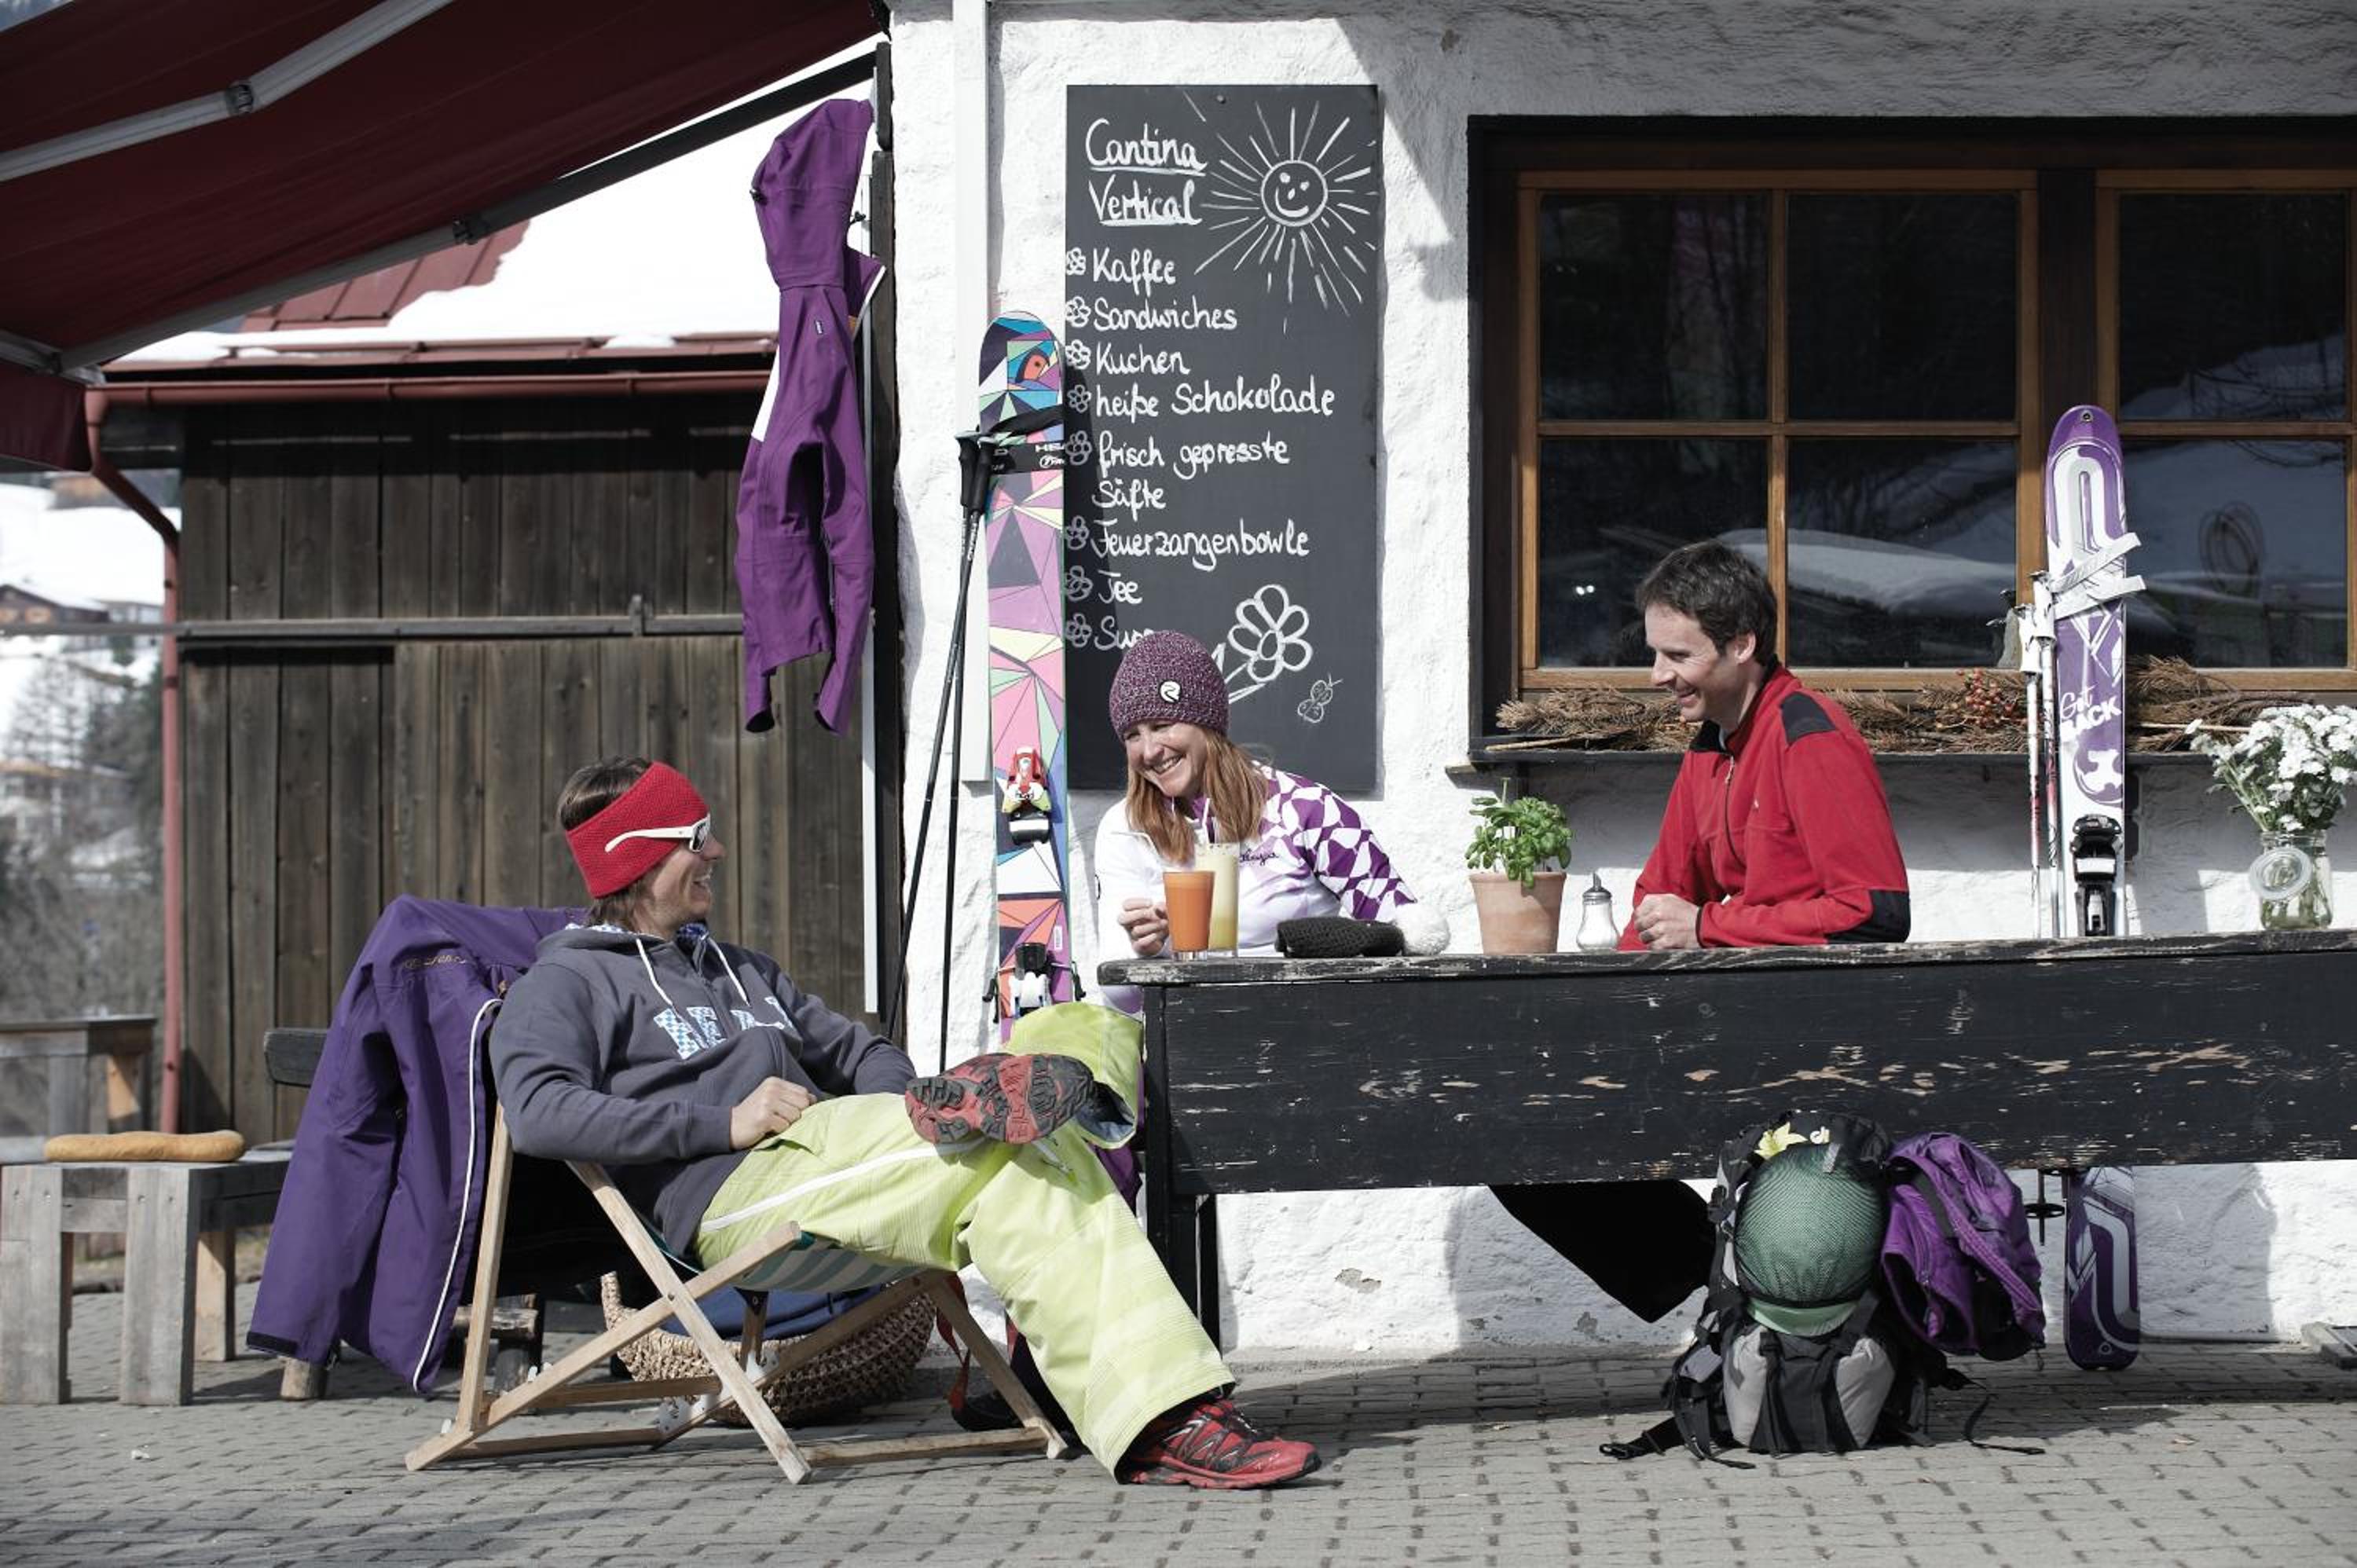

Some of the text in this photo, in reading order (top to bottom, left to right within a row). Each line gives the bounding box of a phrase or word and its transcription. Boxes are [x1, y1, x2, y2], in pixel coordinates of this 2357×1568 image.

[1086, 118, 1208, 171] Cantina
[1088, 174, 1203, 225] Vertical
[1093, 247, 1176, 296] Kaffee
[1093, 295, 1238, 332] Sandwiches
[1096, 341, 1190, 375] Kuchen
[1097, 373, 1335, 423] heiße Schokolade
[1099, 430, 1291, 480] frisch gepresste
[1092, 478, 1167, 522] Säfte
[1091, 518, 1310, 572] Feuerzangenbowle
[1098, 570, 1142, 603] Tee
